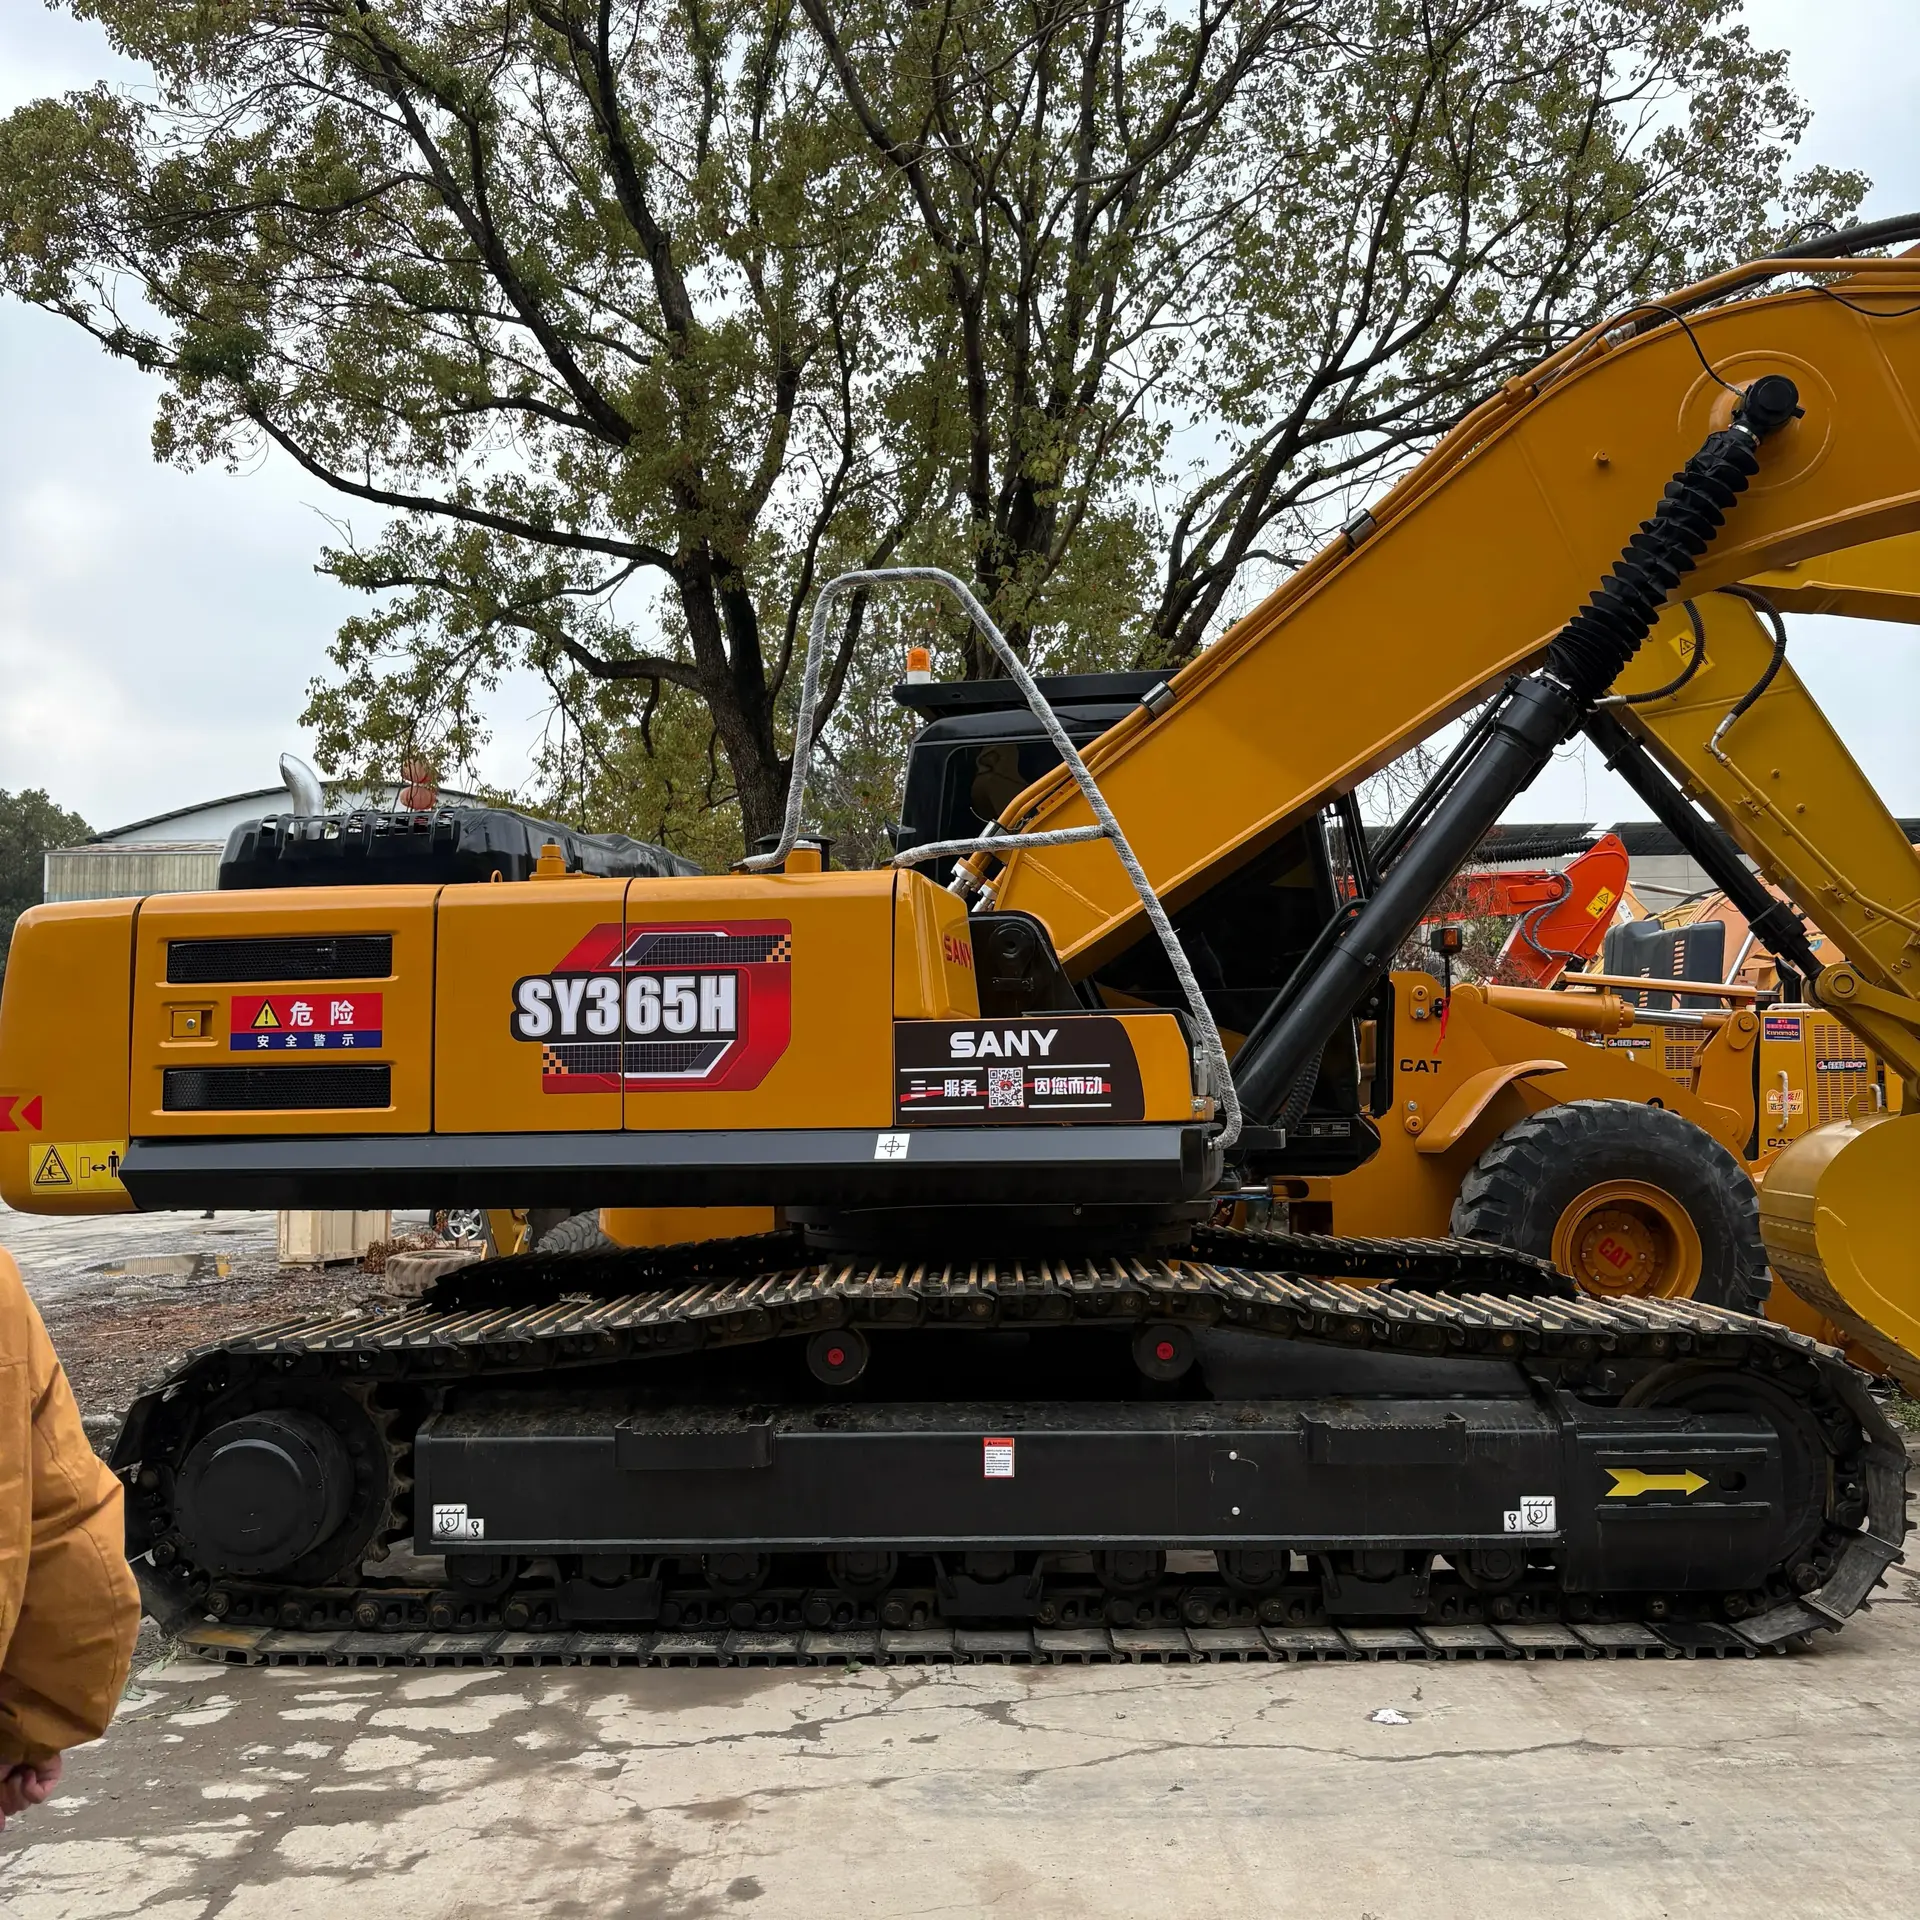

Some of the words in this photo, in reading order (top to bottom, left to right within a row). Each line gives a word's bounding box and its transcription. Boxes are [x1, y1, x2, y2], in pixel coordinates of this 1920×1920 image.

[289, 999, 355, 1026] 危险
[518, 975, 736, 1037] SY365H
[257, 1033, 355, 1048] 安全警示
[949, 1029, 1058, 1058] SANY
[1400, 1058, 1442, 1073] CAT
[910, 1079, 977, 1097] 三一服务
[1034, 1076, 1102, 1095] 因您而动
[1599, 1237, 1633, 1270] CAT
